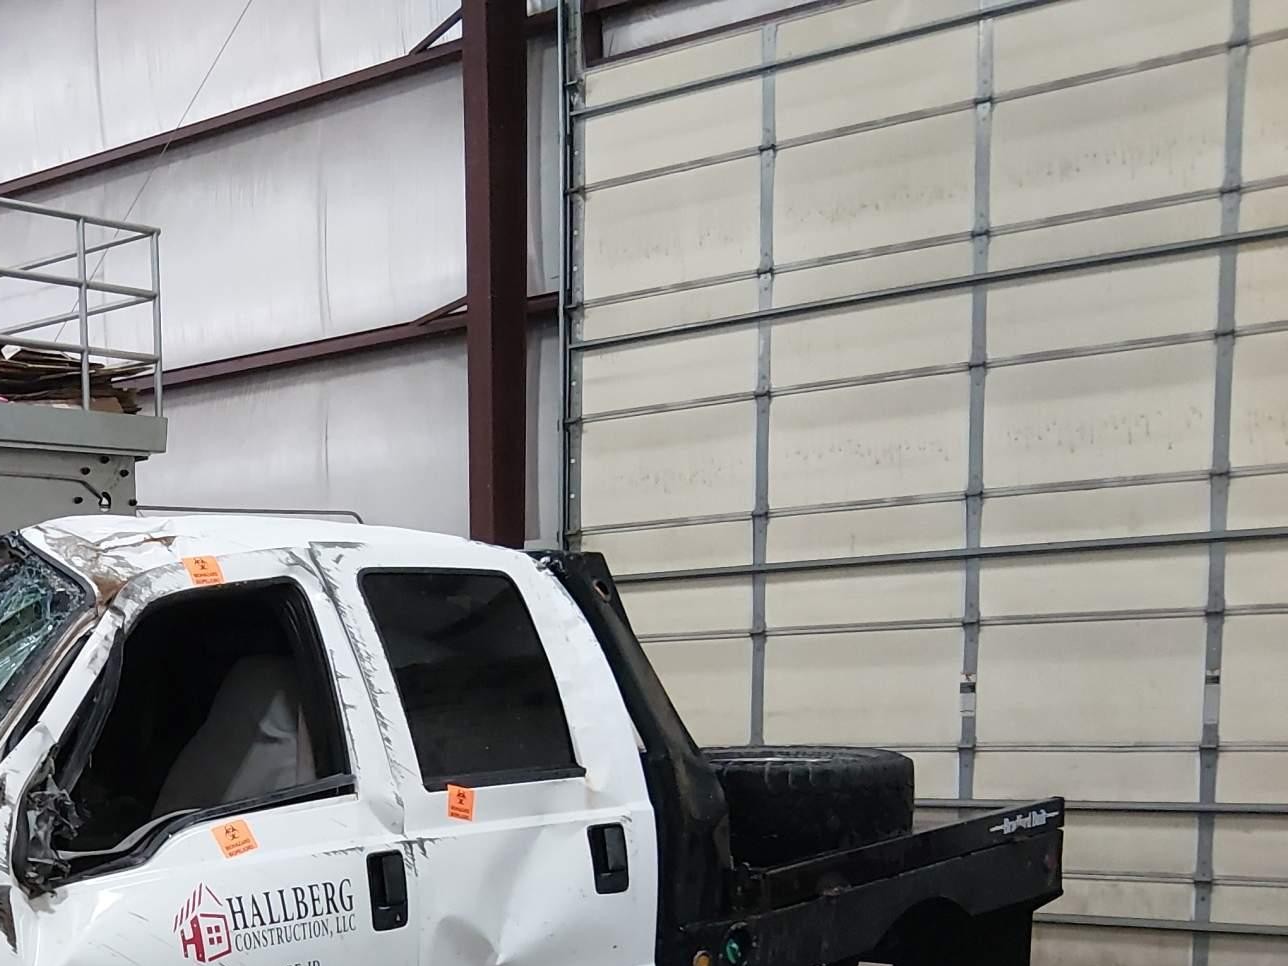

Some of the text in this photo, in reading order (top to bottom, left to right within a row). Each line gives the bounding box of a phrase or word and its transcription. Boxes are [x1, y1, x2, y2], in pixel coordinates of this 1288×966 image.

[226, 878, 354, 931] HALLBERG
[234, 914, 357, 952] CONSTRUCTION, LLC
